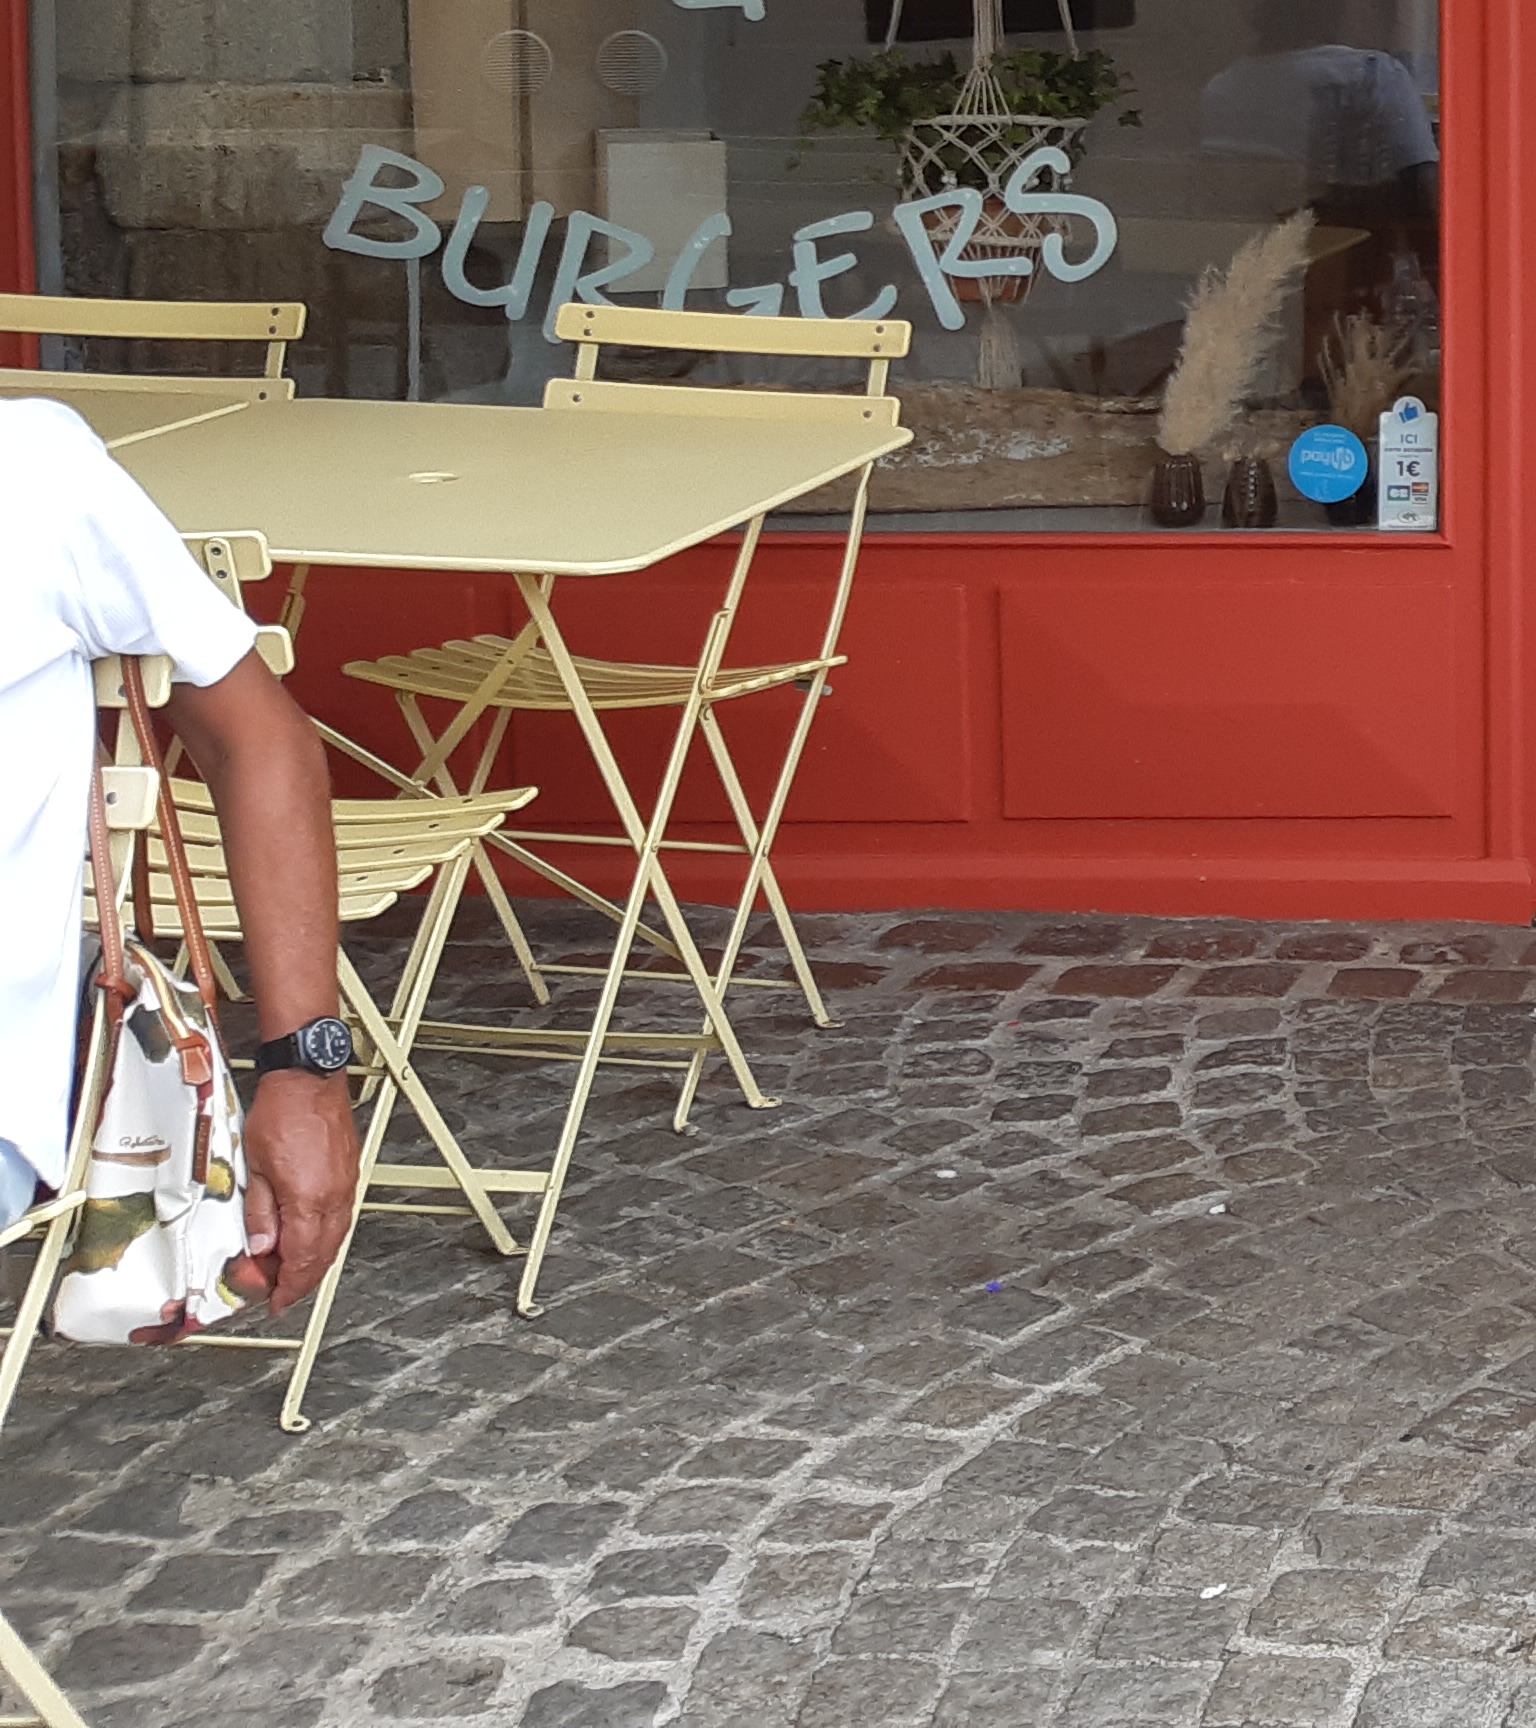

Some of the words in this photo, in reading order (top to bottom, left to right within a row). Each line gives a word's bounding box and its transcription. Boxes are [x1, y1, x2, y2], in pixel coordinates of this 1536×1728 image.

[322, 143, 1117, 345] BURGERS
[1400, 433, 1418, 444] ICI
[1396, 460, 1421, 477] 1€
